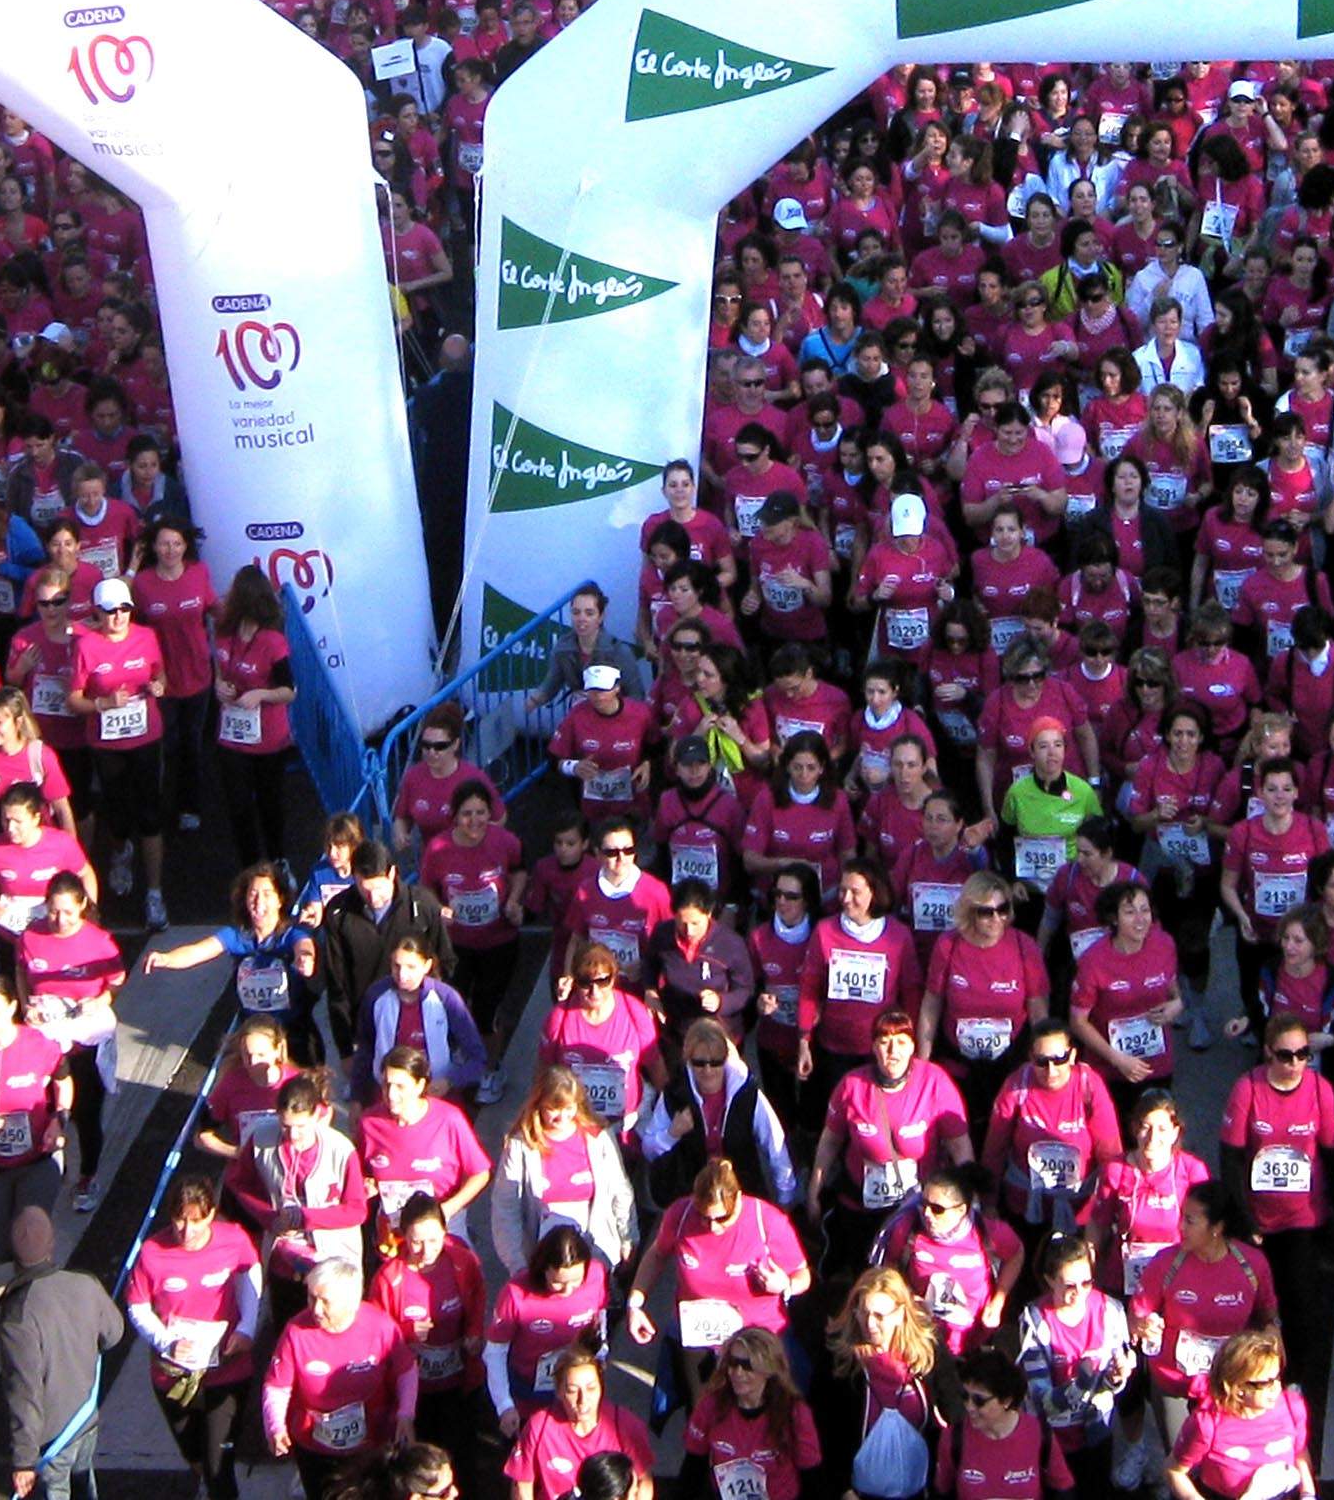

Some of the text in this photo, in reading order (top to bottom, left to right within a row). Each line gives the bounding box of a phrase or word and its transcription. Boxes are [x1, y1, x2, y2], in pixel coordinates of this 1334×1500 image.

[66, 7, 123, 27] CADENA
[634, 44, 792, 91] El Corte Inglés
[502, 259, 518, 283] El
[567, 263, 644, 304] Inglés
[214, 296, 269, 312] CADENA
[232, 411, 295, 428] variedad
[235, 423, 315, 450] musical
[512, 450, 556, 479] Corte
[558, 450, 633, 490] Inglés
[248, 523, 301, 539] CADENA
[483, 624, 498, 649] El
[106, 714, 143, 727] 21153
[1025, 852, 1057, 866] 5398
[676, 860, 712, 875] 14002
[834, 973, 879, 988] 14015
[968, 1036, 1001, 1051] 3620
[1115, 1030, 1158, 1052] 12924
[1263, 1161, 1299, 1177] 3630
